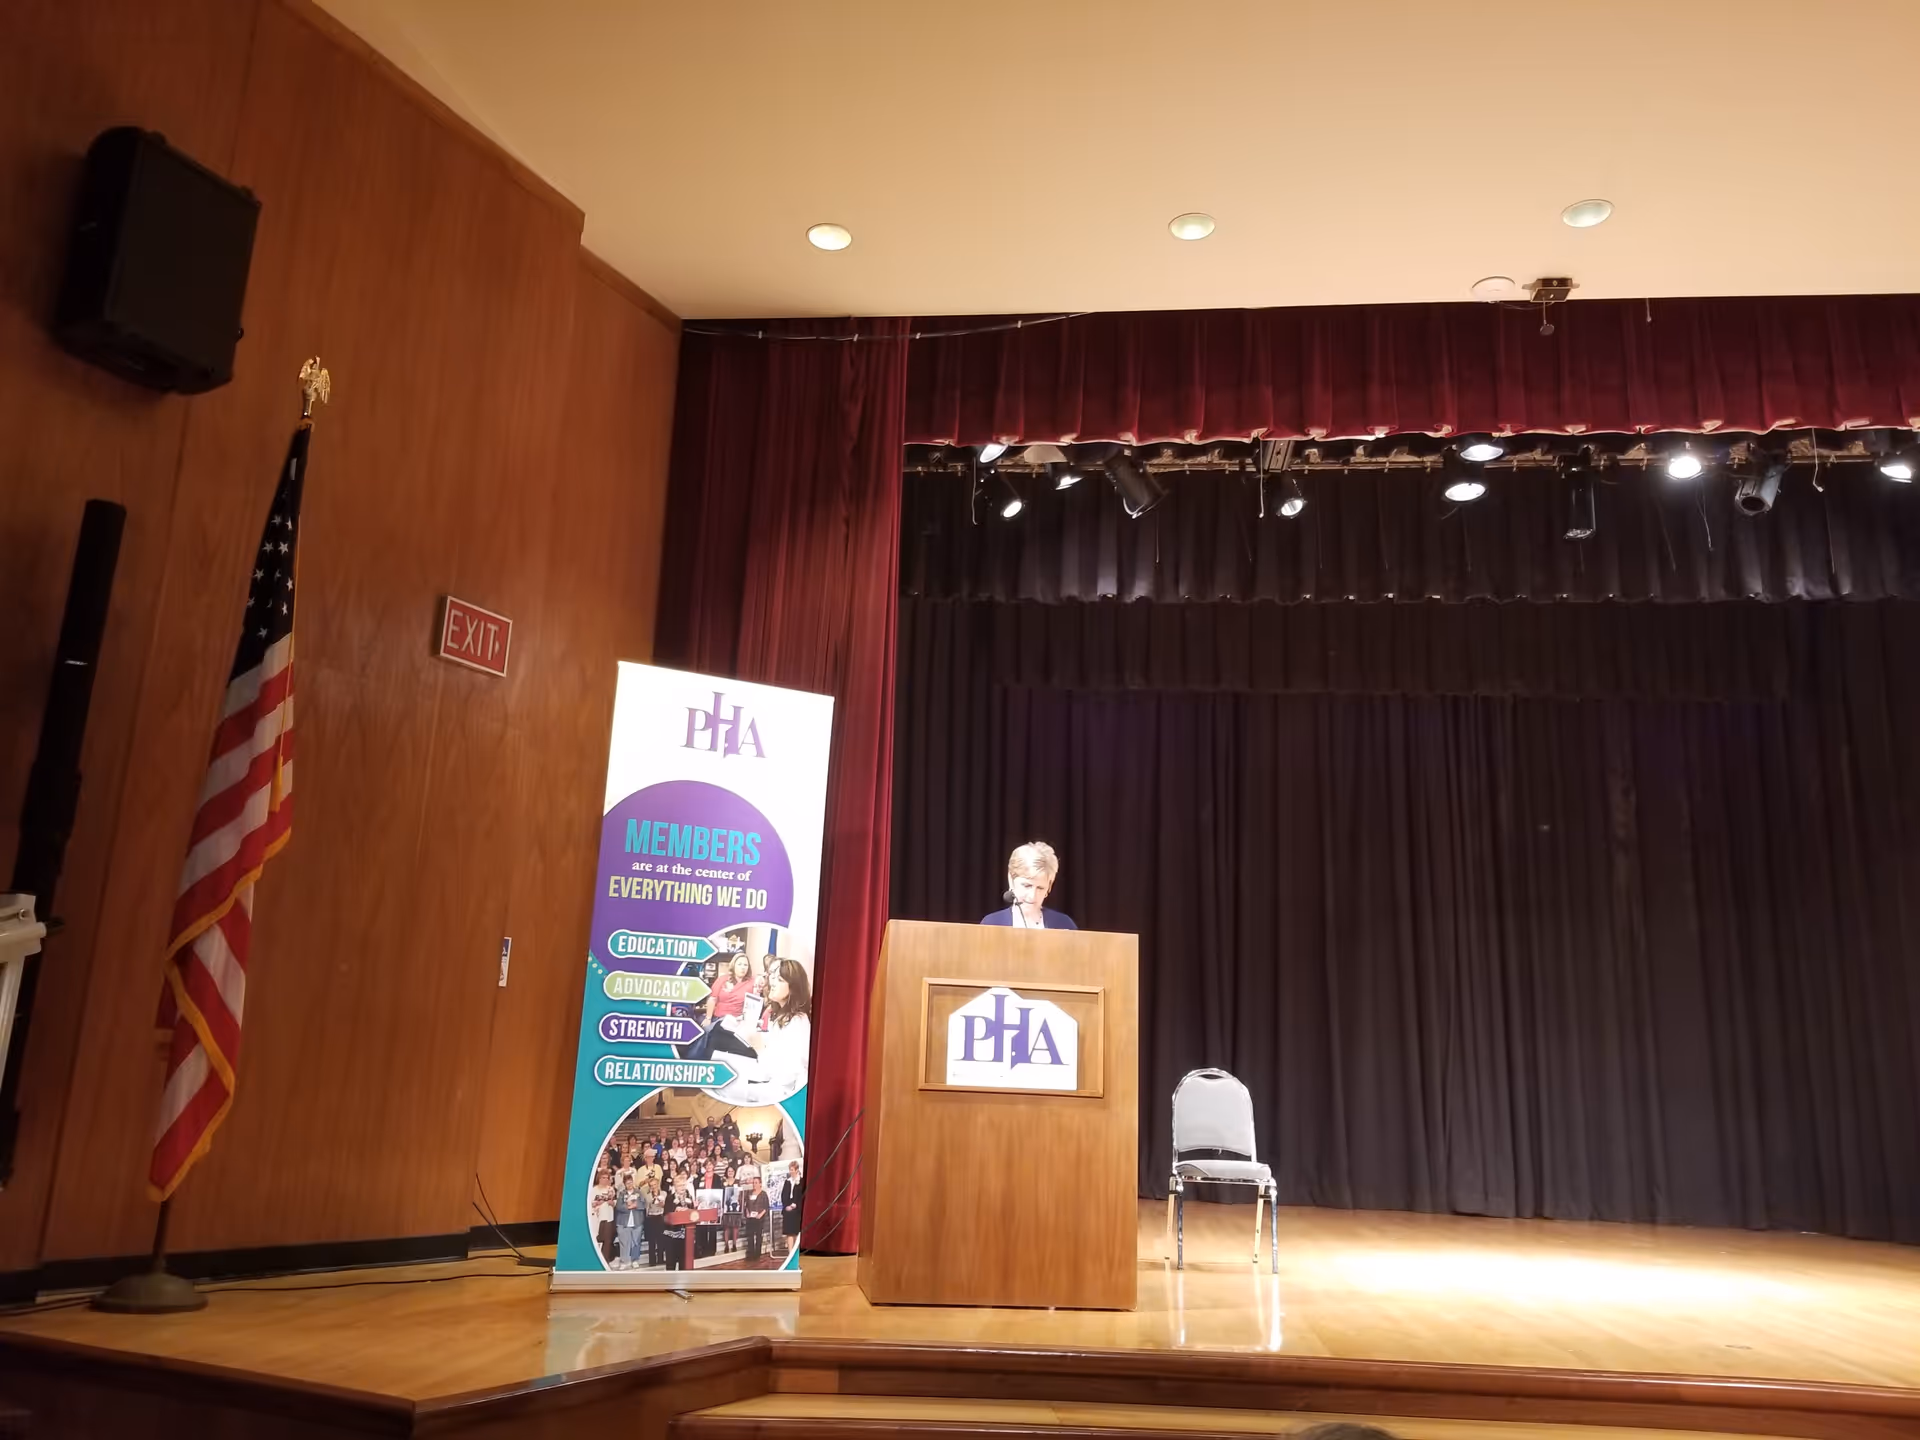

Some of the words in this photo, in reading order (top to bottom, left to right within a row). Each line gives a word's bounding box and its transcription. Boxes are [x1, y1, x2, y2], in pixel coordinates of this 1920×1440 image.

[446, 609, 500, 661] EXIT
[625, 818, 762, 866] MEMBERS
[631, 860, 653, 872] are
[656, 863, 669, 873] at
[671, 863, 692, 876] the
[695, 868, 734, 880] center
[737, 870, 753, 882] of
[608, 875, 713, 906] EVERYTHING
[716, 886, 741, 908] WE
[745, 888, 768, 911] DO
[617, 935, 698, 958] EDUCATION
[613, 977, 689, 999] ADVOCACY
[608, 1018, 683, 1040] STRENGTH
[604, 1061, 716, 1084] RELATIONSHIPS
